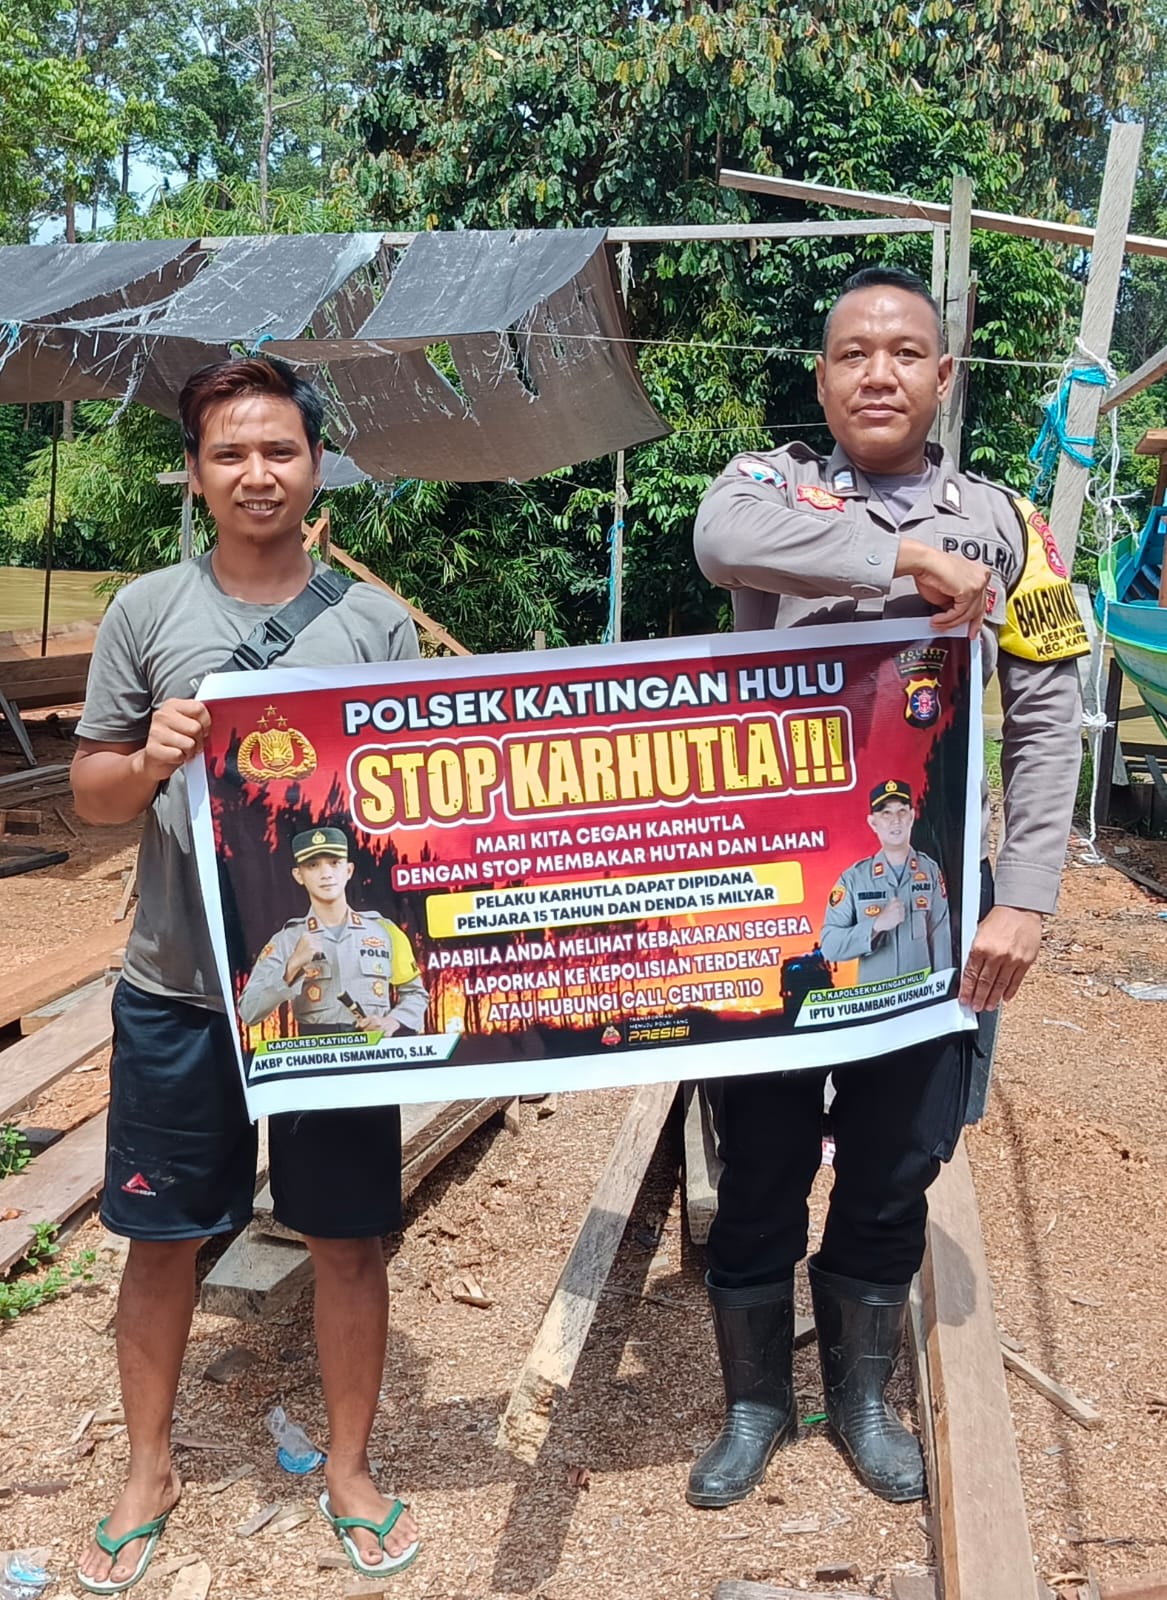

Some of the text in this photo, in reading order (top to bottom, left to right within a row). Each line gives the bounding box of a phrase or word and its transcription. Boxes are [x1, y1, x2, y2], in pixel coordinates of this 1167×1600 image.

[942, 537, 1013, 576] POLRI
[1036, 642, 1064, 656] KEC.
[1041, 629, 1066, 644] DESA
[346, 662, 844, 734] POLSEK KATINGAN HULU
[357, 716, 847, 823] STOP KARHUTLA !!!
[476, 814, 745, 854] MARI KITA CEGAH KARHUTLA
[396, 831, 825, 886] DENGAN STOP MEMBAKAR HUTAN DAN LAHAN
[457, 887, 775, 929] PENJARA 15 TAHUN DAN DENDA 15 MILYAR
[476, 872, 754, 909] PELAKU KARHUTLA DAPAT DIPIDANA
[427, 946, 502, 970] APABILA
[505, 942, 556, 962] ANDA
[559, 935, 633, 958] MELIHAT
[638, 925, 742, 949] KEBAKARAN
[745, 916, 811, 939] SEGERA
[464, 948, 780, 995] LAPORKAN KE KEPOLISIAN TERDEKAT
[827, 986, 870, 999] KAPOLSEK
[872, 979, 906, 992] KATINGAN
[907, 973, 924, 984] HULU
[488, 980, 762, 1021] ATAU HUBUNGI CALL CENTER 110
[809, 1006, 835, 1020] IPTU
[838, 997, 896, 1016] YUBAMBANG
[936, 980, 946, 993] SH
[267, 1035, 368, 1051] KAPOLRES KATINGAN
[628, 1025, 690, 1042] PRESISI
[254, 1045, 438, 1072] AKBP CHANDRA ISMAWANTO, S.I.K.
